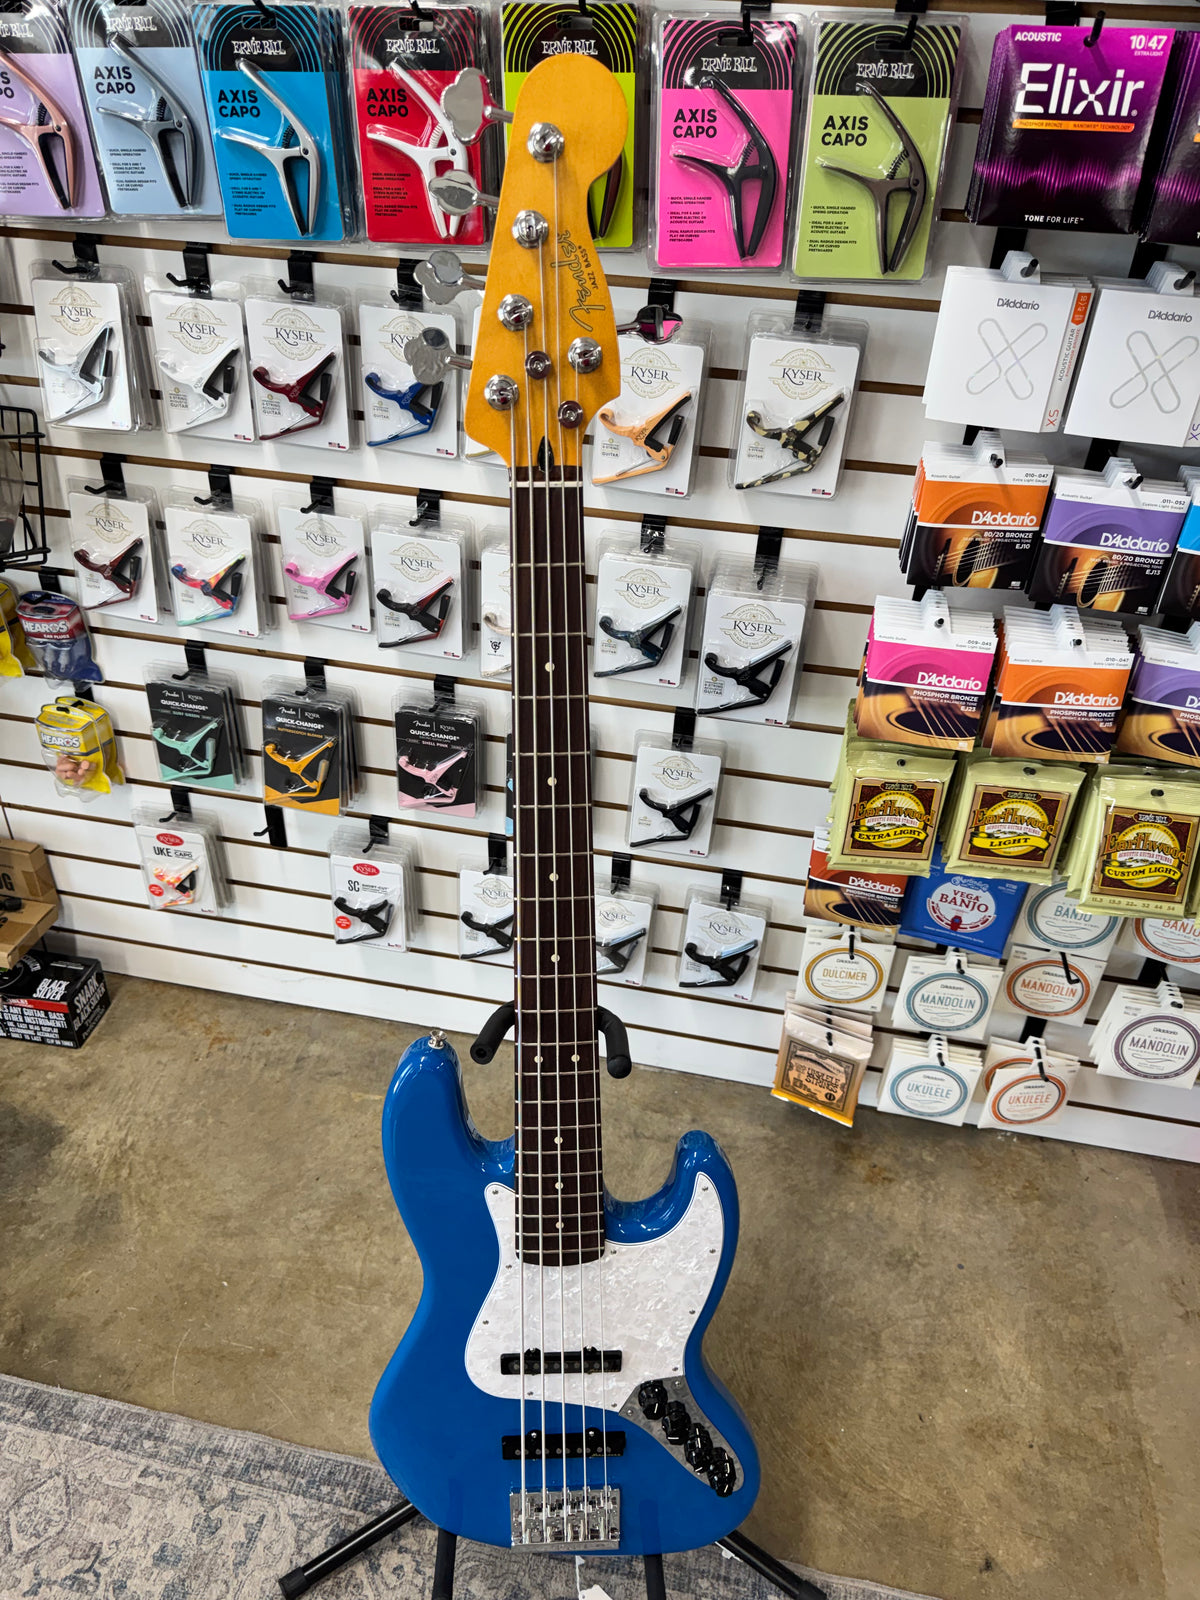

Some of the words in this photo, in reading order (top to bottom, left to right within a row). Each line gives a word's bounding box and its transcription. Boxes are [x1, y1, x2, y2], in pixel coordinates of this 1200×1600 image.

[135, 16, 157, 31] BALL
[385, 35, 415, 53] ERNIE
[416, 39, 440, 54] BALL
[1014, 32, 1062, 42] ACOUSTIC
[232, 37, 262, 55] ERNIE
[263, 40, 286, 55] BALL
[572, 40, 598, 55] BALL
[701, 53, 731, 71] ERNIE
[732, 56, 757, 72] BALL
[856, 59, 887, 78] ERNIE
[888, 63, 914, 80] BALL
[94, 66, 132, 80] AXIS
[95, 82, 136, 95] CAPO
[367, 88, 407, 103] AXIS
[218, 89, 258, 104] AXIS
[219, 105, 260, 118] CAPO
[367, 104, 409, 118] CAPO
[673, 108, 717, 123] AXIS
[823, 115, 869, 131] AXIS
[673, 125, 717, 138] CAPO
[821, 132, 867, 147] CAPO
[1024, 214, 1045, 222] TONE
[1045, 215, 1061, 223] FOR
[580, 248, 592, 269] BASS
[587, 271, 599, 290] JAZZ
[996, 297, 1040, 311] D'Addario
[60, 305, 96, 322] KYSER
[1148, 310, 1193, 323] D'Addario
[179, 321, 218, 340] KYSER
[274, 327, 317, 346] KYSER
[1058, 351, 1070, 381] ACOUSTIC
[1067, 328, 1076, 351] GUITAR
[631, 366, 671, 384] KYSER
[782, 367, 823, 386] KYSER
[1046, 409, 1060, 427] XS
[95, 517, 127, 532] KYSER
[971, 511, 1037, 527] D'Addario
[192, 533, 226, 548] KYSER
[306, 531, 339, 546] KYSER
[1099, 532, 1170, 552] D'Addario
[400, 556, 435, 571] KYSER
[1135, 556, 1165, 565] BRONZE
[626, 582, 661, 598] KYSER
[22, 619, 69, 633] HEAROS
[733, 620, 773, 637] KYSER
[917, 671, 982, 691] D'Addario
[913, 690, 950, 699] PHOSPHOR
[950, 693, 979, 702] BRONZE
[1054, 691, 1119, 706] D'Addario
[1050, 709, 1087, 717] PHOSPHOR
[40, 731, 81, 748] HEAROS
[662, 766, 694, 780] KYSER
[853, 800, 936, 825] Earthwood
[973, 808, 1058, 836] Earthwood
[858, 832, 891, 840] EXTRA
[893, 829, 922, 838] LIGHT
[989, 837, 1028, 847] LIGHT
[153, 846, 173, 857] UKE
[1104, 832, 1192, 865] Earthwood
[1108, 868, 1146, 877] CUSTOM
[1148, 867, 1178, 877] LIGHT
[348, 880, 360, 892] SC
[848, 876, 901, 894] D'Addario
[939, 893, 989, 913] BANJO
[953, 889, 980, 902] VEGA
[708, 920, 742, 936] KYSER
[822, 968, 868, 982] DULCIMER
[39, 977, 70, 991] BLACK
[1020, 978, 1078, 998] MANDOLIN
[33, 986, 65, 1001] SILVER
[74, 971, 99, 1014] SNARK
[920, 993, 976, 1010] MANDOLIN
[1129, 1036, 1190, 1057] MANDOLIN
[807, 1067, 841, 1085] UKULELE
[907, 1082, 953, 1099] UKULELE
[1008, 1093, 1052, 1105] UKULELE
